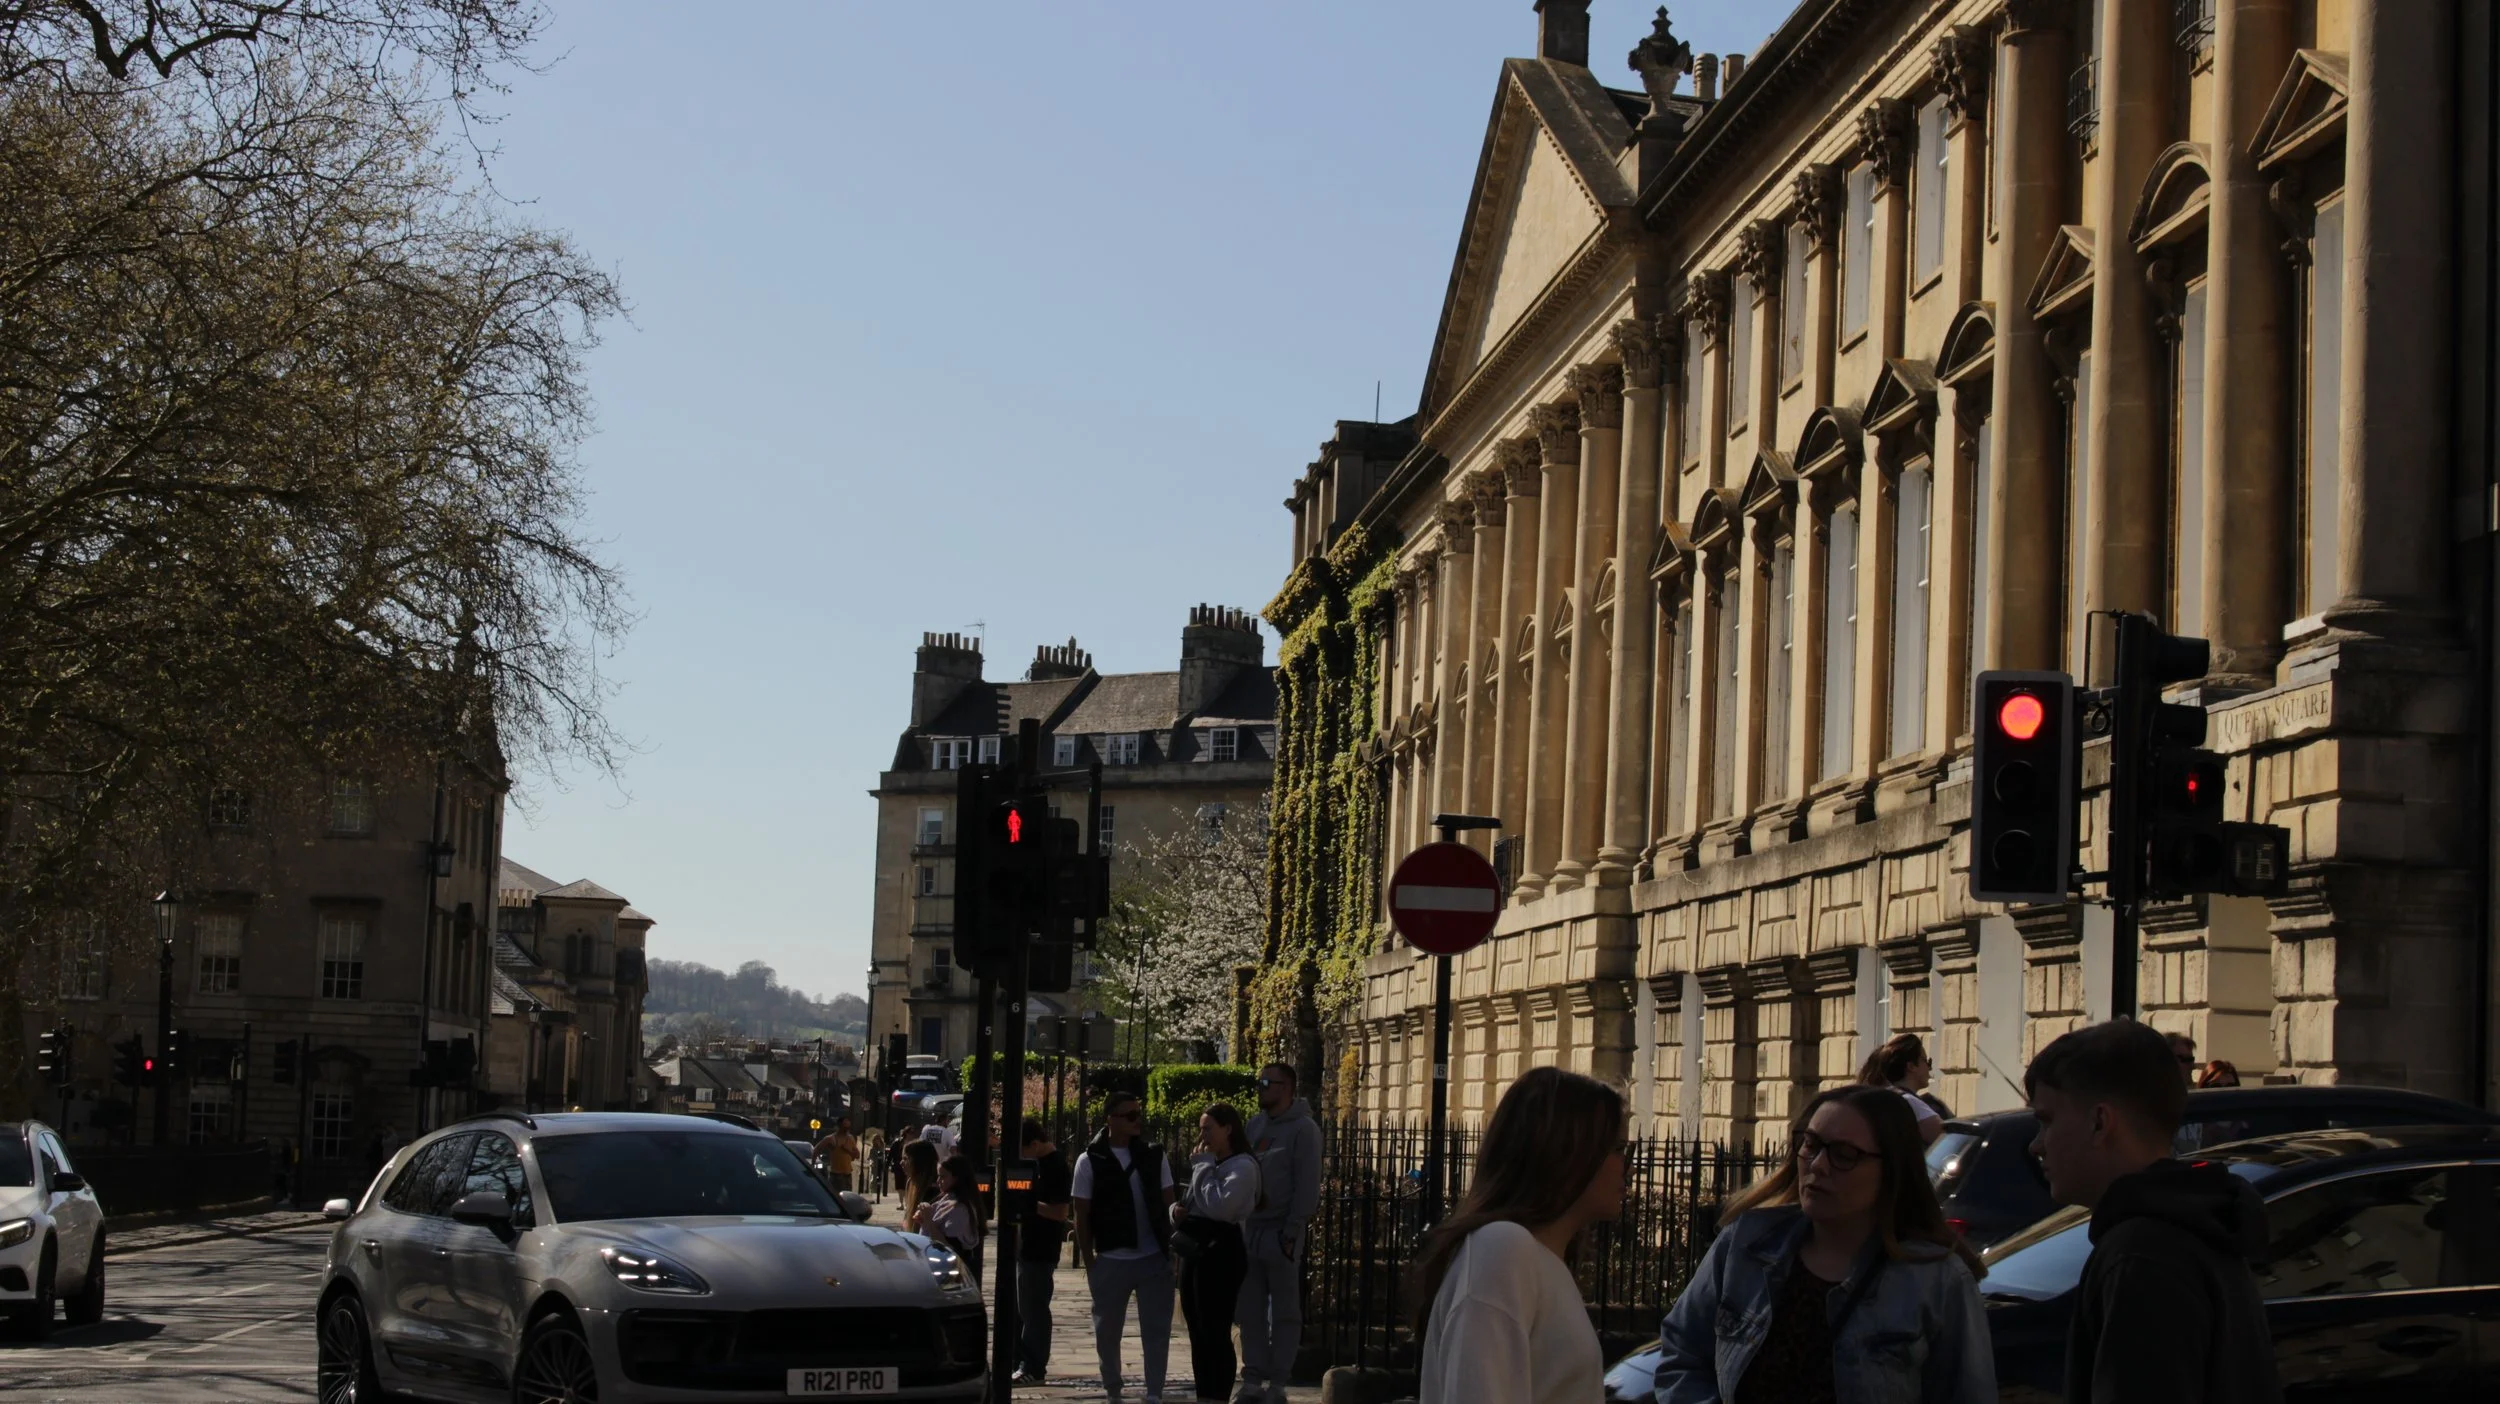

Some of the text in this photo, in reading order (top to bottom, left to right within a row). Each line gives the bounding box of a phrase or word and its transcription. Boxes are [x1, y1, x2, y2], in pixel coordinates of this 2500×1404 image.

[2273, 689, 2329, 726] SQUARE
[2122, 904, 2132, 916] 7
[1012, 1002, 1020, 1013] 6
[984, 1026, 992, 1035] 5
[1007, 1179, 1032, 1190] WAIT
[846, 1370, 884, 1390] PRO
